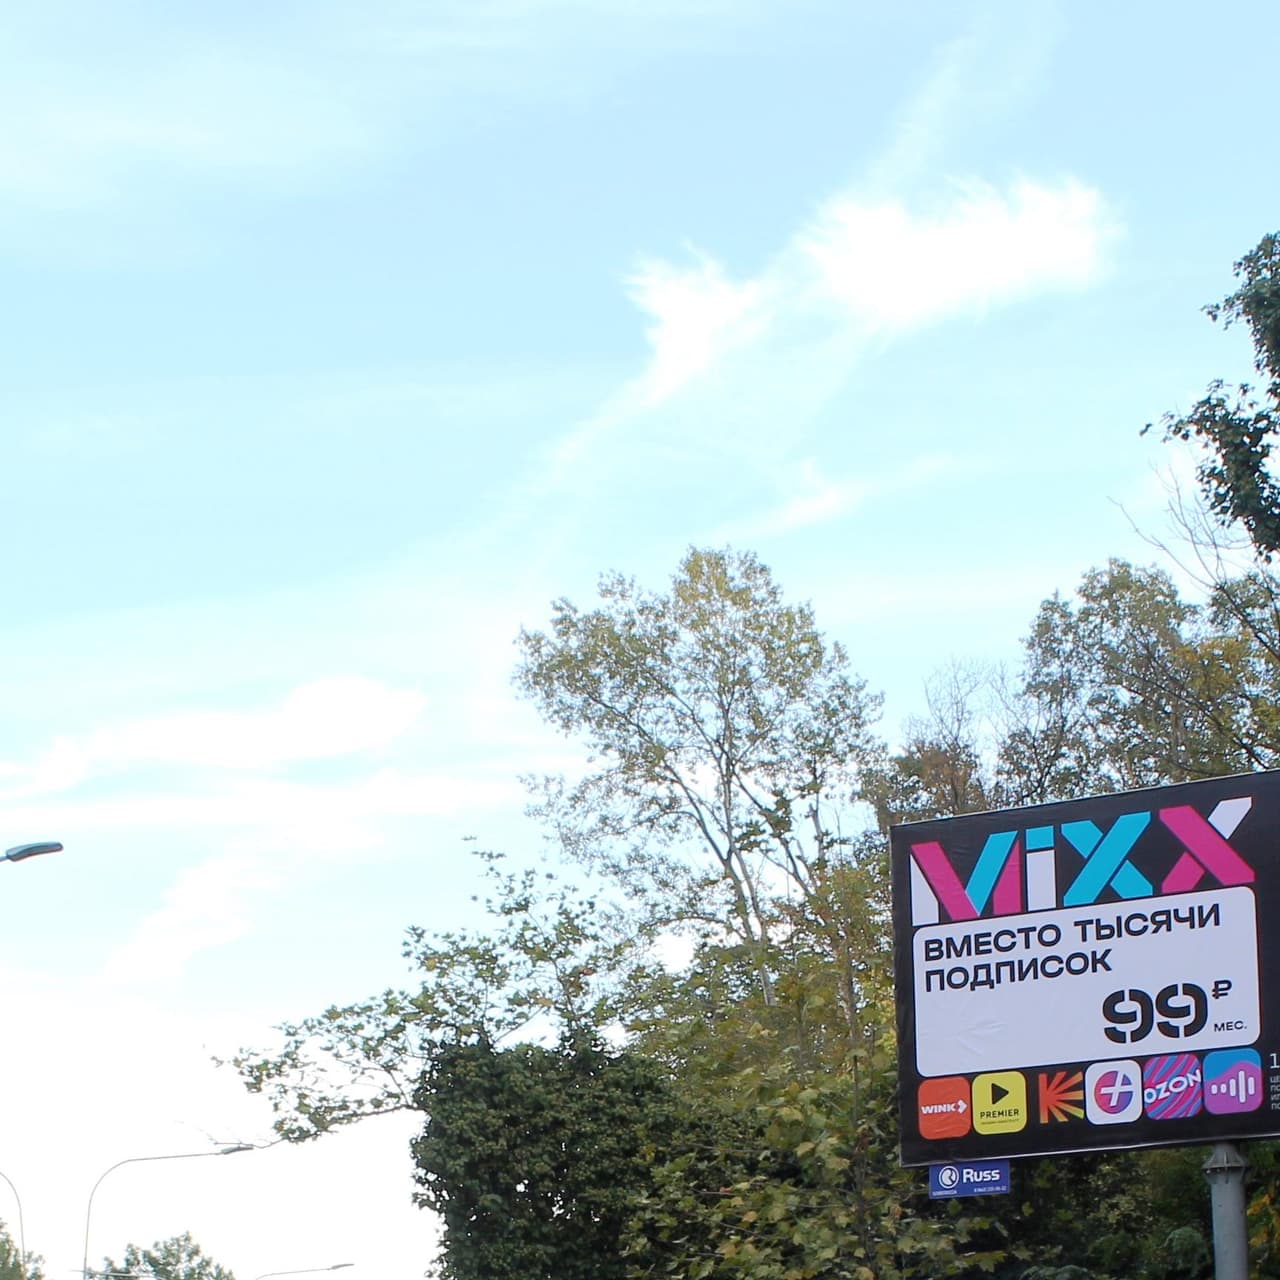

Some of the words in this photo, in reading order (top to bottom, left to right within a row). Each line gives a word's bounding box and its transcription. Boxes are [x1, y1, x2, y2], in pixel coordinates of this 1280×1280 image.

[924, 924, 1061, 962] ВМЕСТО
[1073, 903, 1221, 943] ТЫСЯЧИ
[925, 949, 1113, 993] ПОДПИСОК
[1214, 1020, 1248, 1033] МЕС.
[1144, 1069, 1202, 1104] OZON
[921, 1102, 956, 1114] WINK
[979, 1108, 1020, 1119] PREMIER
